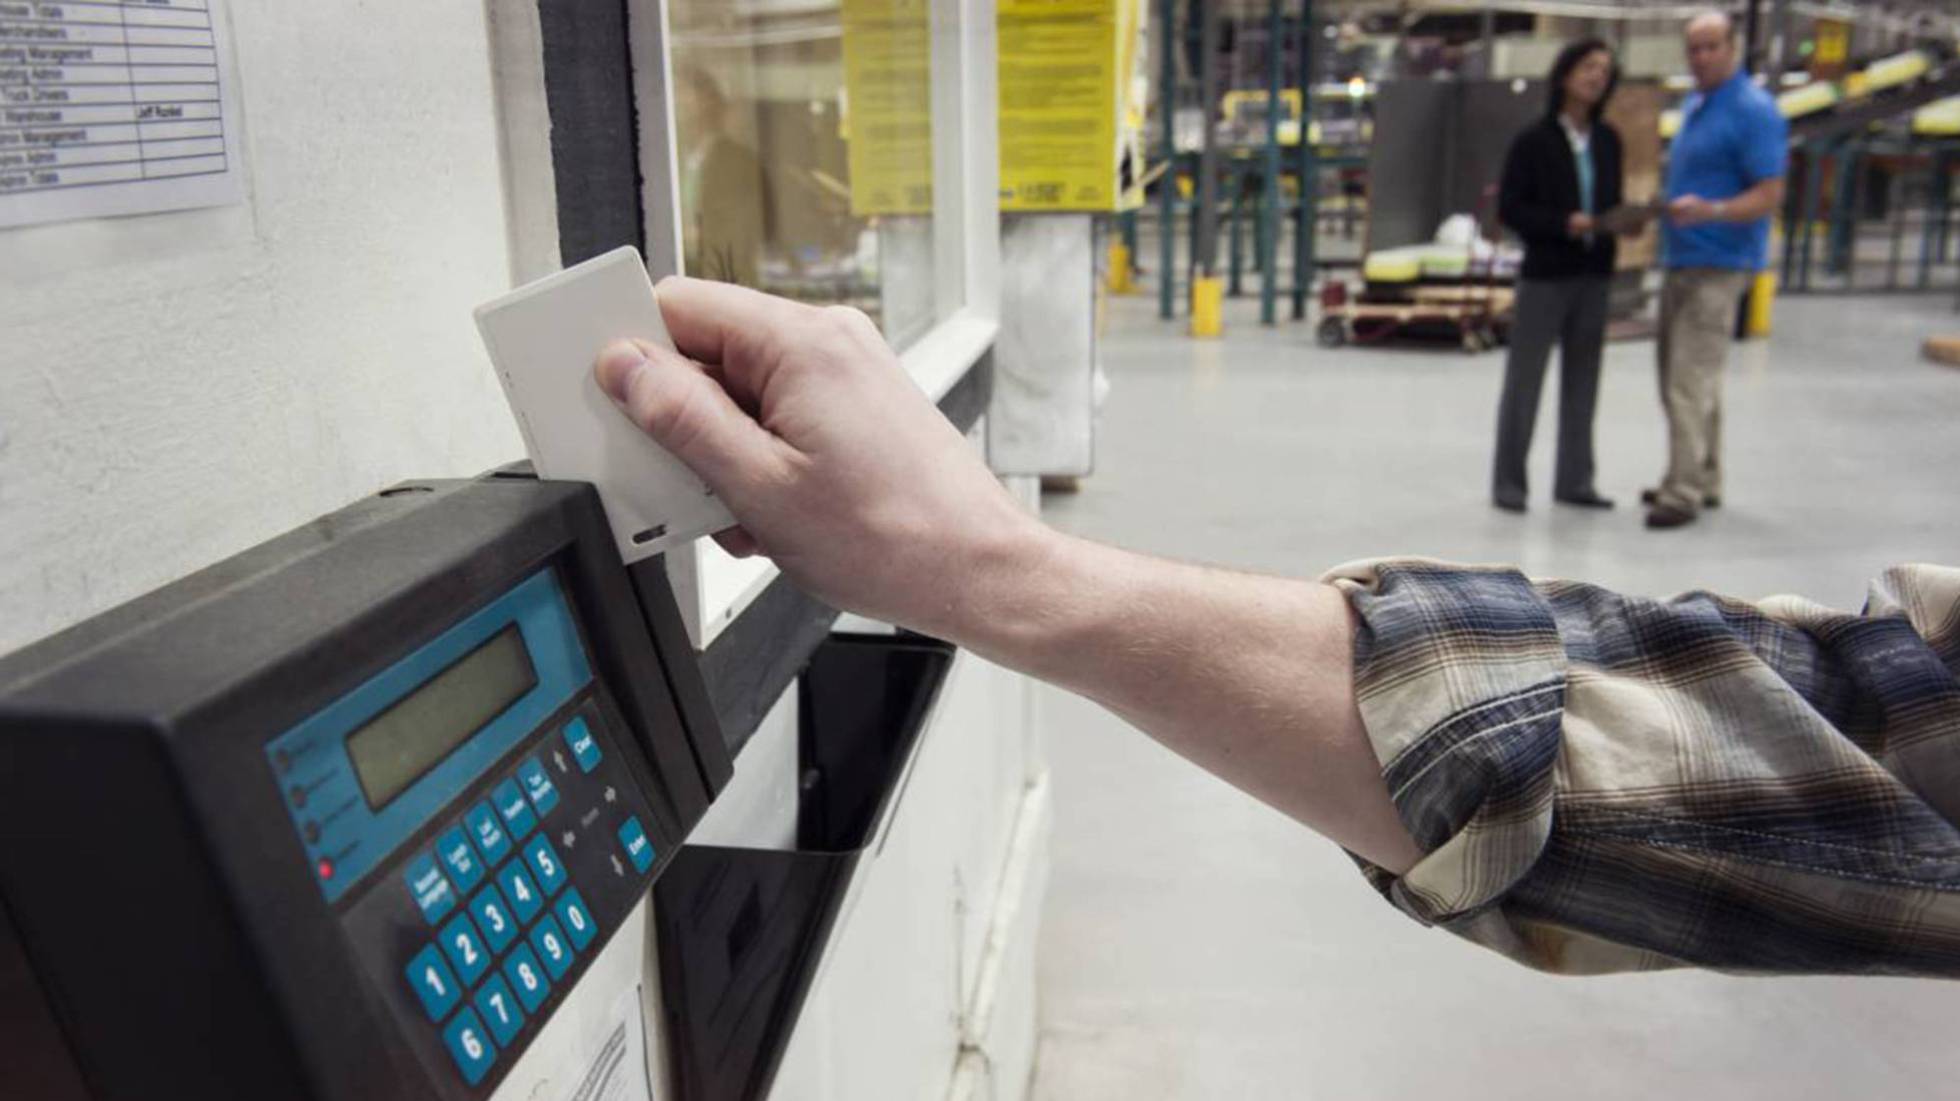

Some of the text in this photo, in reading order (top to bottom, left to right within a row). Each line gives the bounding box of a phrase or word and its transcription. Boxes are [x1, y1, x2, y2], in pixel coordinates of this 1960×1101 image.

[537, 849, 555, 876] 5
[513, 875, 531, 901] 4
[485, 904, 504, 932] 3
[567, 904, 585, 930] 0
[456, 933, 478, 965] 2
[543, 932, 562, 960] 9
[425, 965, 446, 996] 1
[517, 962, 537, 991] 8
[490, 992, 509, 1024] 7
[461, 1028, 483, 1060] 6
